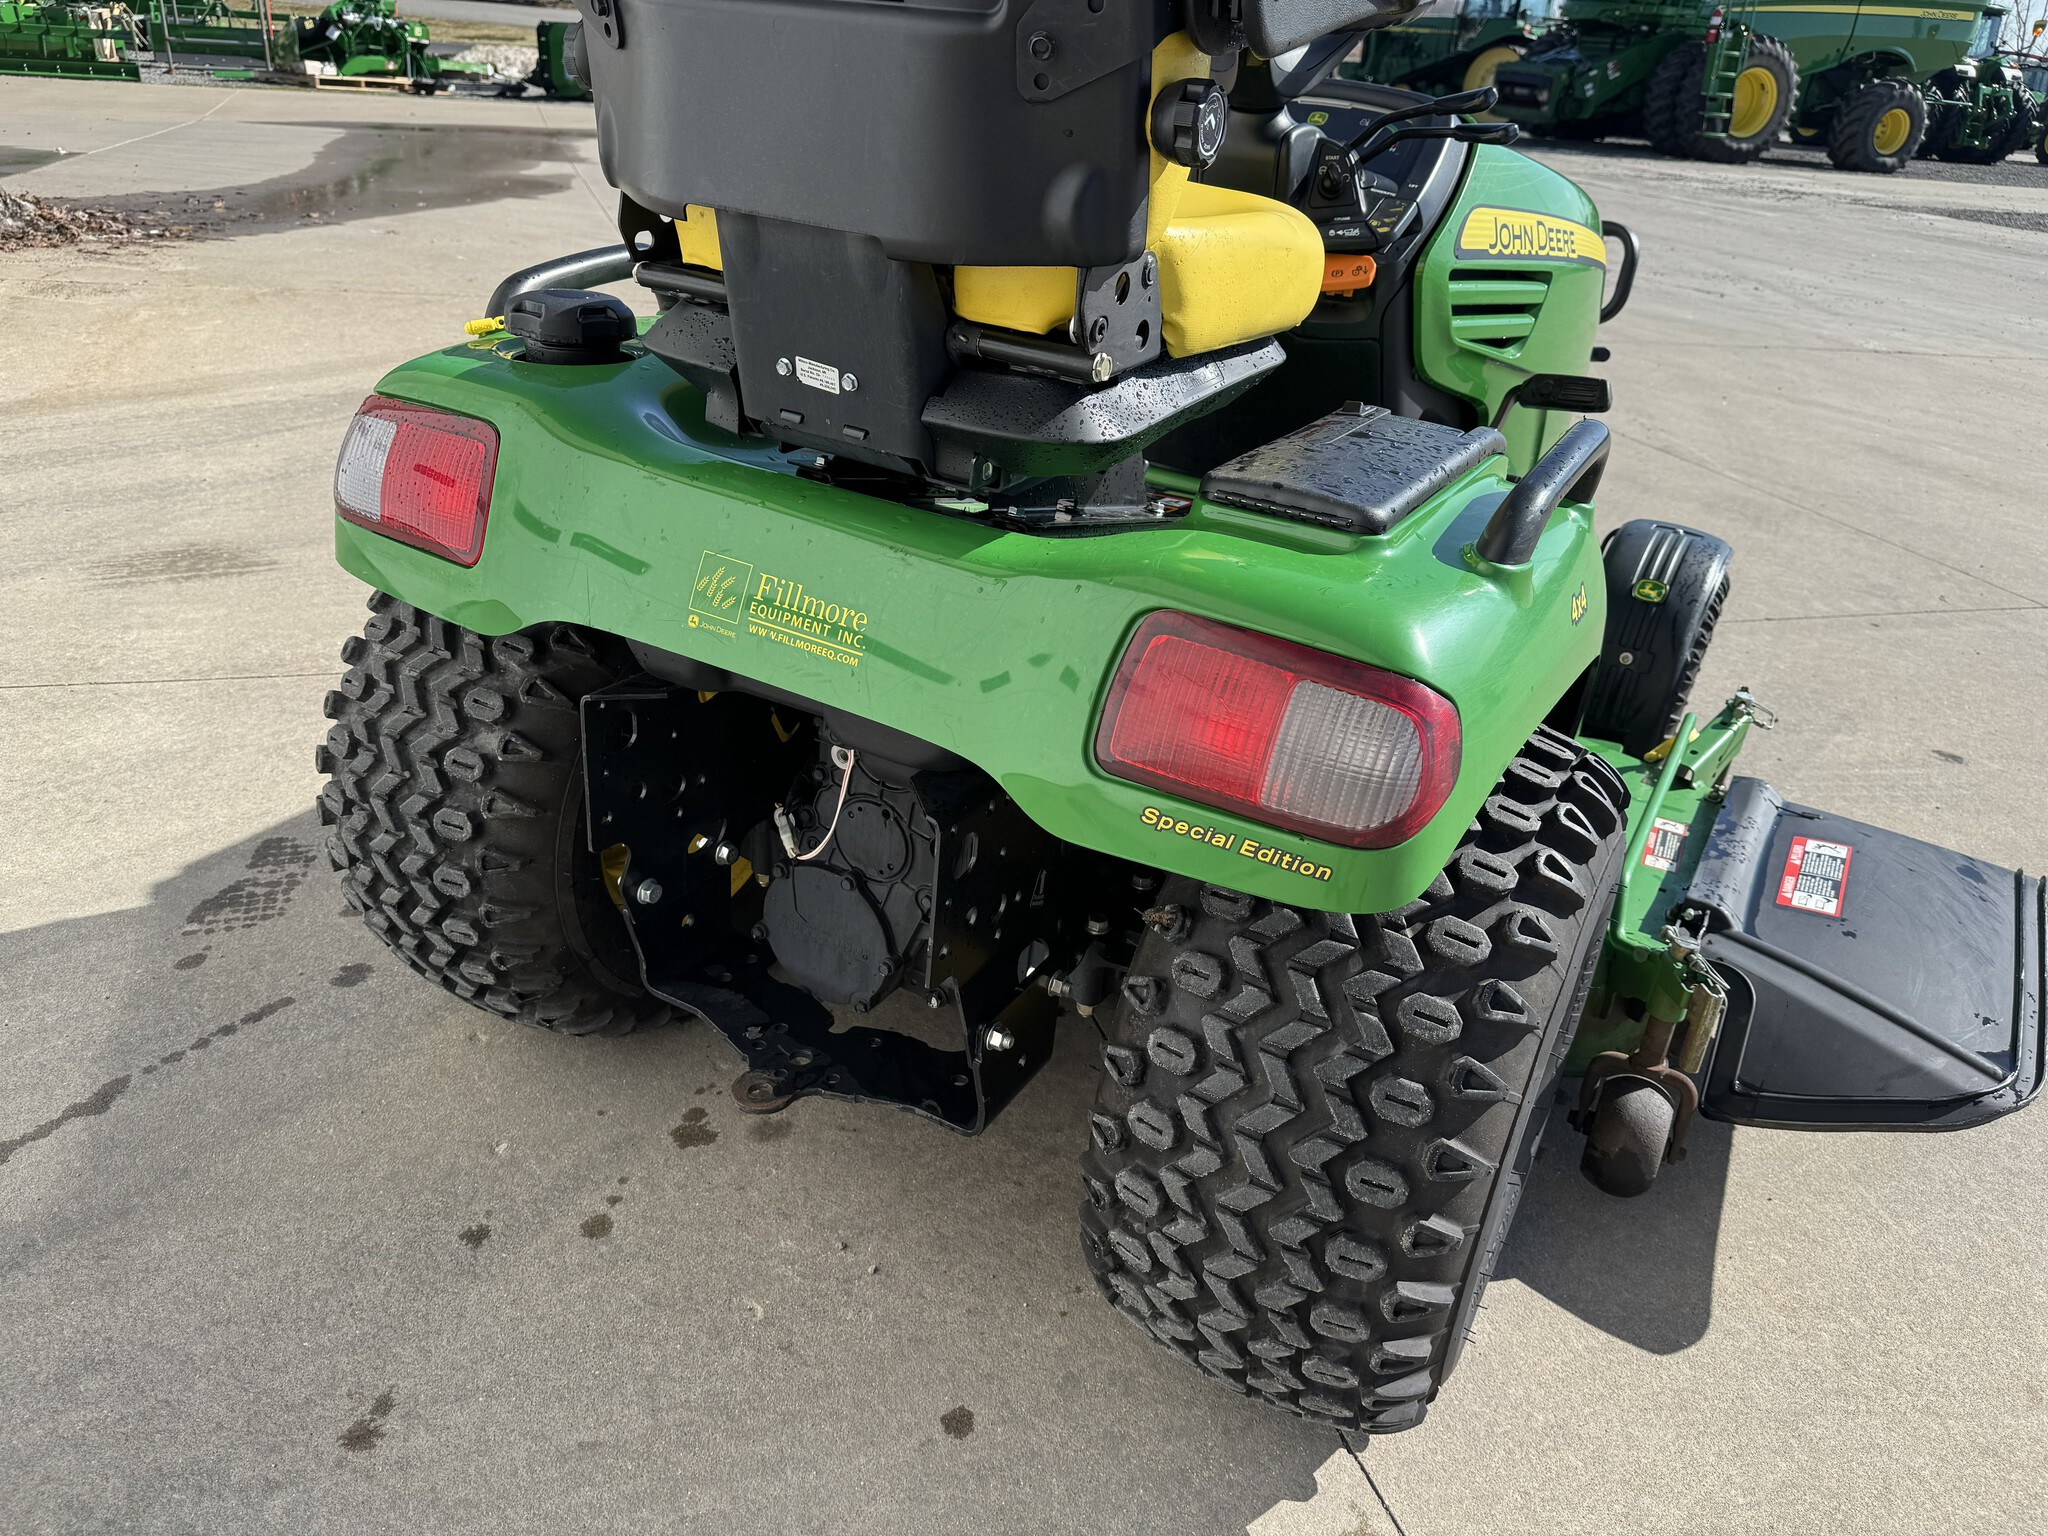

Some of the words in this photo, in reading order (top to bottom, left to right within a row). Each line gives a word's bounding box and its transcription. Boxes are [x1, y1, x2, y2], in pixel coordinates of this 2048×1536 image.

[1489, 217, 1534, 250] JOHN
[1536, 220, 1577, 254] DEERE
[753, 573, 868, 632] Fillmore
[1571, 584, 1587, 622] 4x4
[699, 621, 717, 633] JOHN
[715, 624, 737, 640] DEERE
[749, 601, 832, 637] EQUIPMENT
[836, 629, 867, 650] INC.
[1140, 806, 1236, 850] Special
[1237, 837, 1334, 883] Edition
